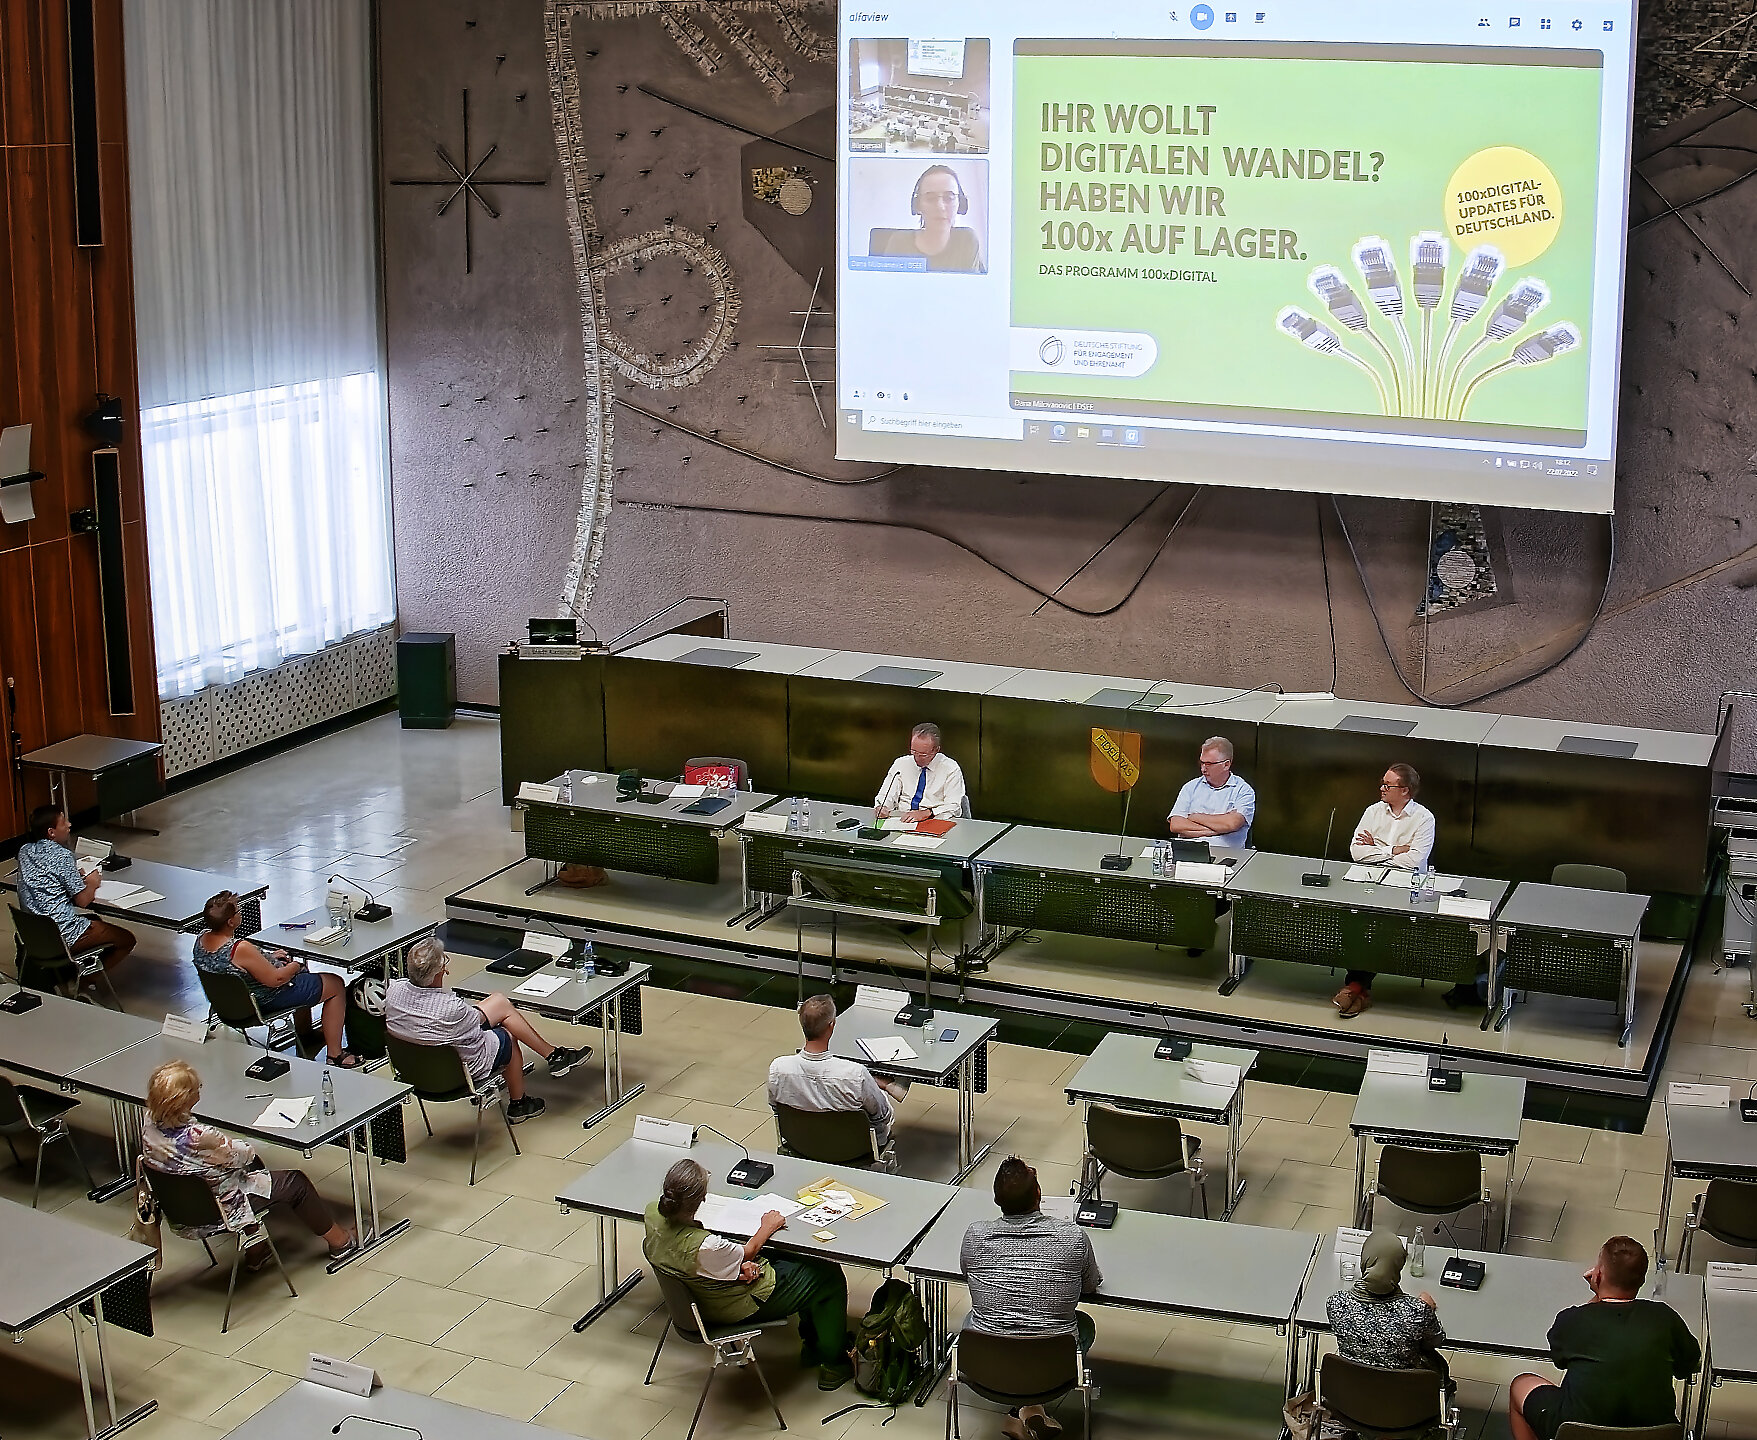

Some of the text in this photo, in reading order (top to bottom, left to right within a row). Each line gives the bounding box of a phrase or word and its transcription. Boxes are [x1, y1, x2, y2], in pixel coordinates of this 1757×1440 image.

[849, 12, 889, 22] alfaview
[1041, 102, 1217, 136] IHR WOLLT
[1040, 142, 1386, 183] DIGITALEN WANDEL?
[1040, 181, 1227, 217] HABEN WIR
[1457, 179, 1542, 204] 100xDIGITAL-
[1458, 193, 1546, 219] UPDATES FÜR
[1455, 209, 1555, 236] DEUTSCHLAND.
[1040, 220, 1308, 261] 100x AUF LAGER.
[1038, 264, 1218, 283] DAS PROGRAMM 100xDIGITAL
[1073, 340, 1143, 351] DEUTSCHE STIFTUNG
[1073, 349, 1133, 359] FÜR ENGAGEMENT
[1073, 359, 1126, 369] UND EHRENAMT
[880, 417, 963, 430] Suchbegriff hier eingeben
